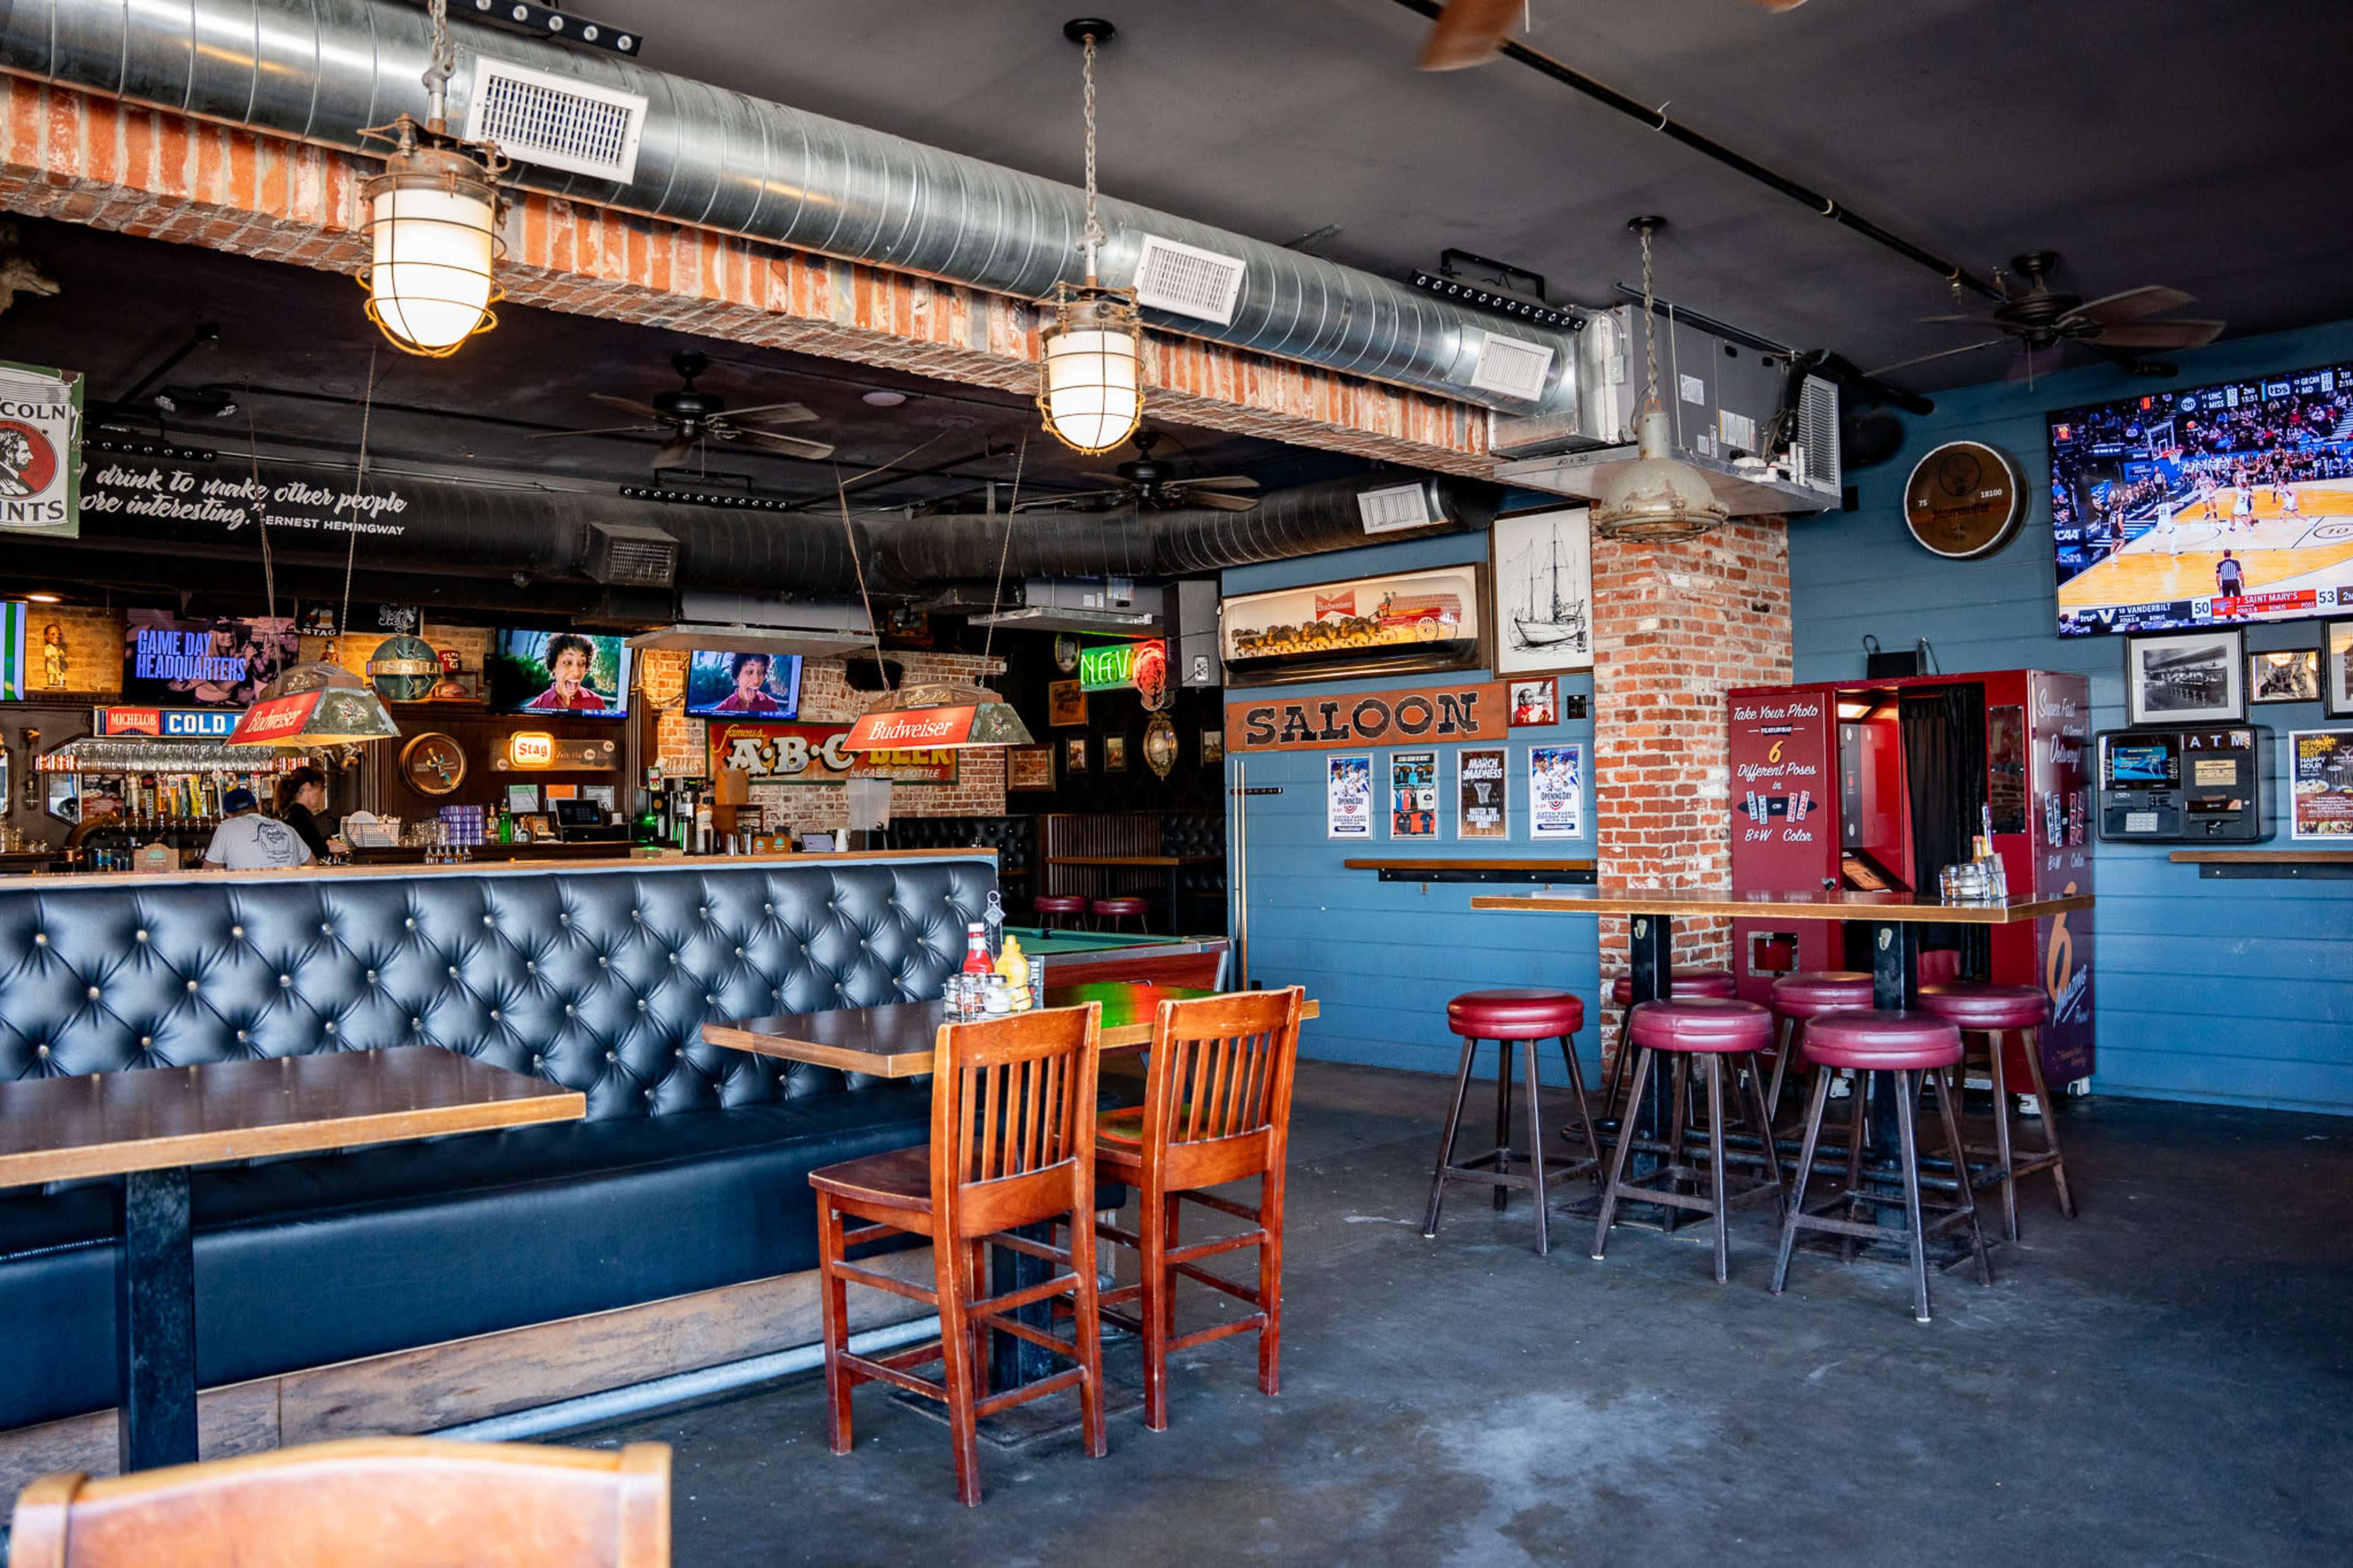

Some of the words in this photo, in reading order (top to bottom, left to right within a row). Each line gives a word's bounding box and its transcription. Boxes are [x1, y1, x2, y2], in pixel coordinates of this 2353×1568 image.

[2208, 392, 2222, 401] UNC
[2208, 400, 2224, 409] MISS
[96, 464, 162, 491] drink
[169, 470, 195, 492] to
[202, 477, 270, 500] make
[274, 482, 335, 506] other
[334, 492, 407, 519] people
[80, 491, 123, 513] ore
[324, 521, 405, 535] HEMINGWAY
[2245, 594, 2267, 604] SAINT
[2268, 592, 2298, 602] MARY'S
[2319, 591, 2335, 604] 53
[1317, 601, 1352, 612] Budweiser
[2126, 604, 2171, 614] VANDERBILT
[2194, 602, 2209, 614] 50
[302, 627, 336, 637] STAG
[137, 629, 181, 655] GAME
[184, 632, 213, 656] DAY
[135, 654, 245, 681] HEADQUARTERS
[1246, 692, 1479, 746] SALOON
[1733, 706, 1757, 721] Take
[1759, 705, 1786, 719] Your
[1787, 703, 1819, 718] Photo
[111, 713, 156, 725] MICHELOB
[169, 714, 225, 733] COLD
[245, 707, 302, 733] Budweiser
[868, 719, 953, 741] Budweiser
[712, 724, 767, 753] famous
[518, 742, 548, 757] Stag
[1768, 740, 1784, 764] 6
[1468, 757, 1499, 770] MARCH
[862, 768, 888, 777] CASE
[904, 769, 941, 778] BOTTLE
[1462, 768, 1503, 780] MADNESS
[1737, 763, 1784, 782] Different
[1786, 762, 1817, 776] Poses
[1773, 780, 1783, 790] in
[1783, 828, 1813, 842] Color
